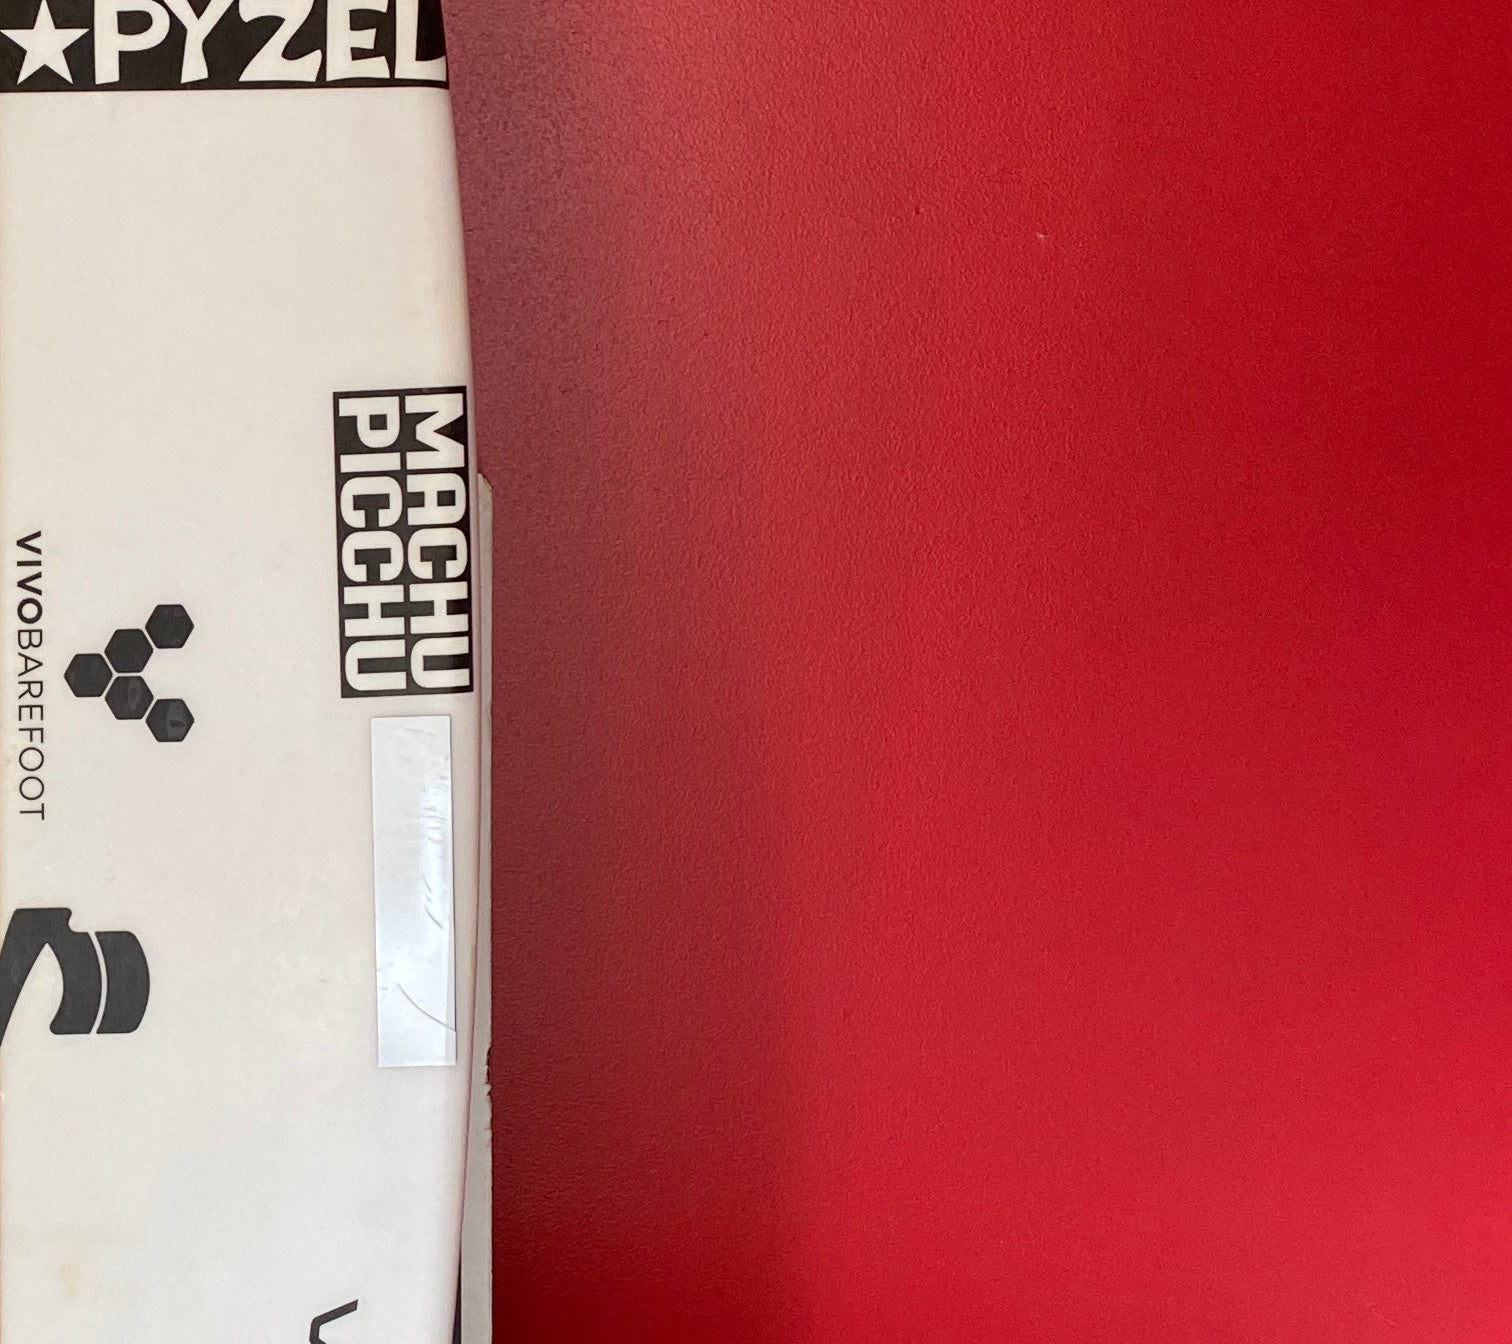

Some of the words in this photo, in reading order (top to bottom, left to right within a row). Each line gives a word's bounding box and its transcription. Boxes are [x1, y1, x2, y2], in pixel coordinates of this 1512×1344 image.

[15, 529, 47, 821] VIVOBAREFOOT
[338, 396, 407, 692] PICCHU
[404, 394, 471, 690] MACHU
